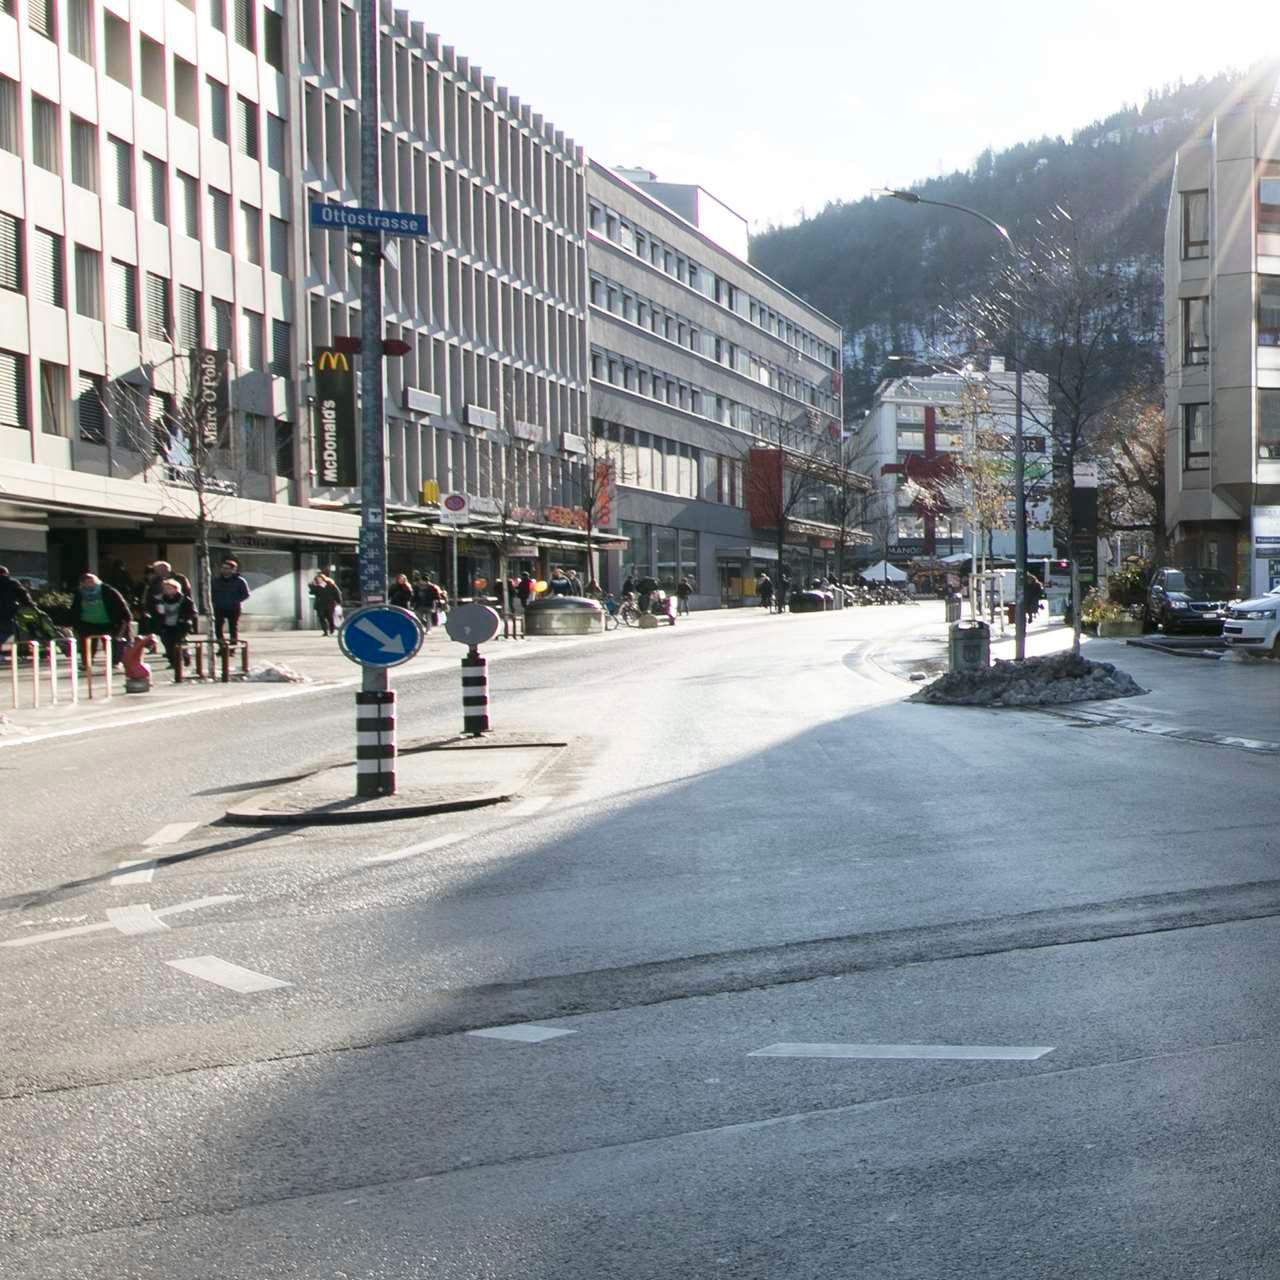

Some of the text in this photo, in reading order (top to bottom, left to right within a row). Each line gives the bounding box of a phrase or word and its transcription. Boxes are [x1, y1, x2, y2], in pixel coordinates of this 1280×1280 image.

[321, 206, 419, 231] Ottostrasse
[203, 404, 218, 445] Marc
[322, 399, 338, 483] McDonald's
